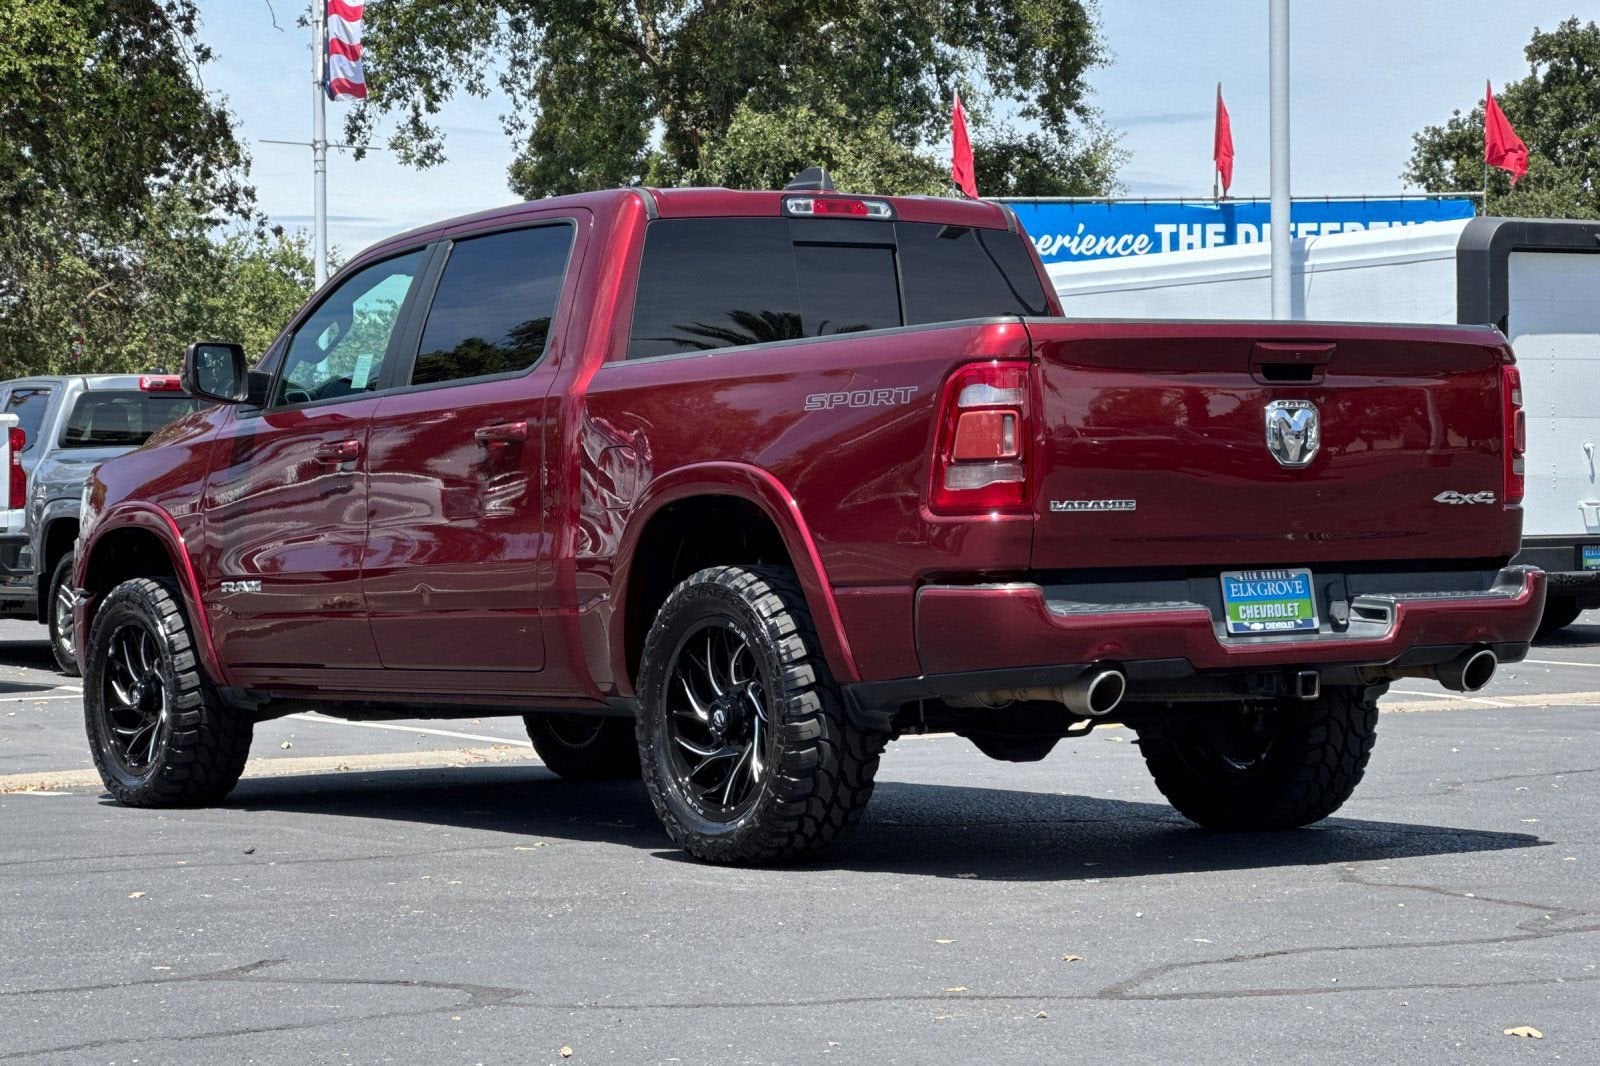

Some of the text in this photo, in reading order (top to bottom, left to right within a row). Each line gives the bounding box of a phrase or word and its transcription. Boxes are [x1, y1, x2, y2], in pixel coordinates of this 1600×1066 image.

[1154, 223, 1226, 253] THE
[804, 386, 918, 411] SPORT
[1050, 500, 1136, 511] LARAMIE
[221, 580, 262, 592] RAM
[1230, 580, 1305, 598] ELK GROVE
[1238, 602, 1300, 619] CHEVROLET
